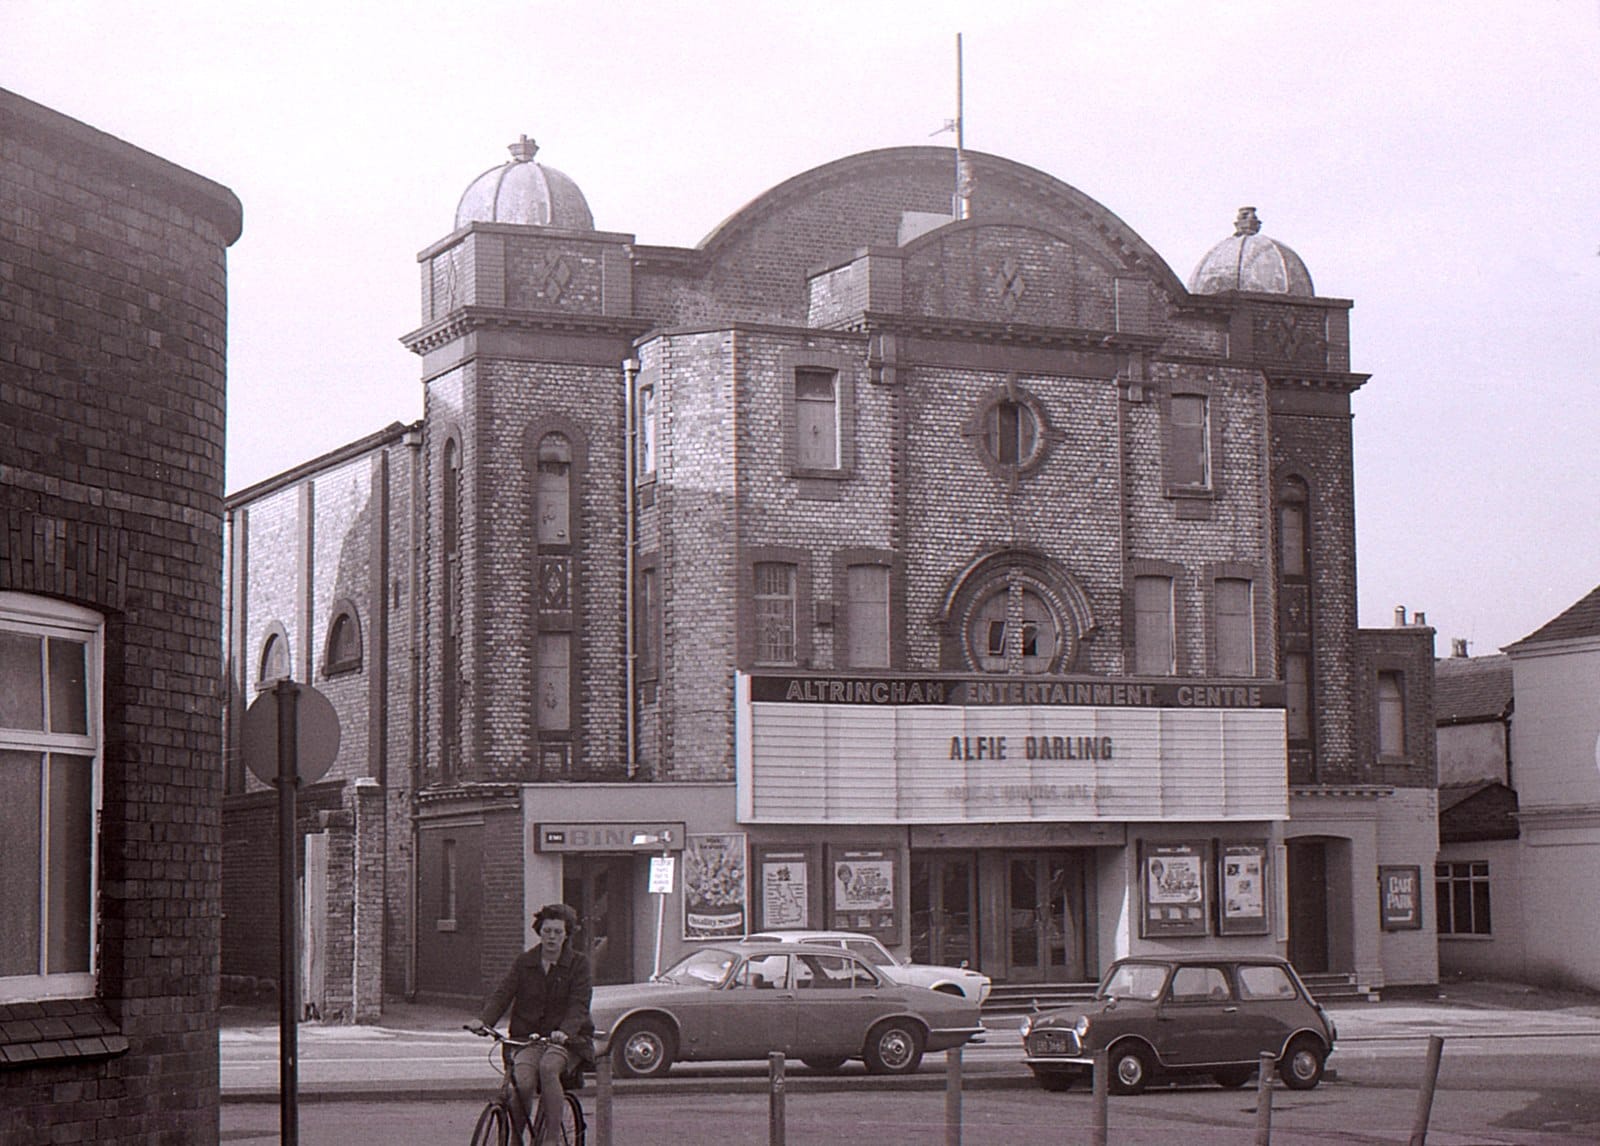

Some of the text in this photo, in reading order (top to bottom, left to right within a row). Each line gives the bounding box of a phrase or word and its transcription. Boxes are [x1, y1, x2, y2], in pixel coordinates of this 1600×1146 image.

[786, 680, 1261, 707] ALTRINCHAM ENTERTAINMENT CENTRE
[950, 736, 1113, 761] ALFIE DARLING
[570, 829, 674, 846] BINO
[1389, 876, 1413, 893] CAR
[1387, 893, 1414, 909] PARK
